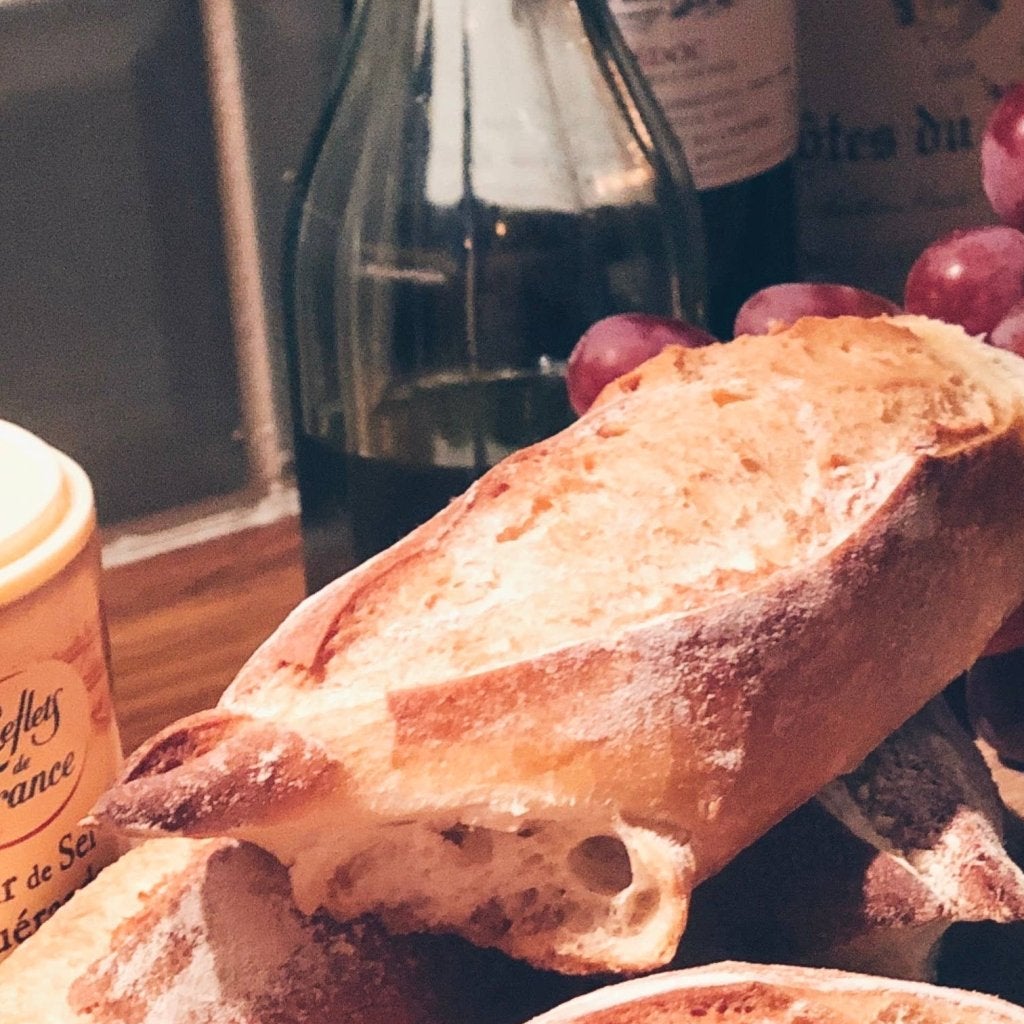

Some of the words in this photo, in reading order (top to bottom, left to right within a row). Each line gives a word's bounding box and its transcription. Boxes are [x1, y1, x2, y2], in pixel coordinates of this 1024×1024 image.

[798, 109, 898, 161] ôtes
[913, 104, 973, 155] du
[0, 688, 64, 756] eflets
[0, 751, 75, 809] rance
[12, 753, 31, 775] de
[27, 864, 53, 890] de
